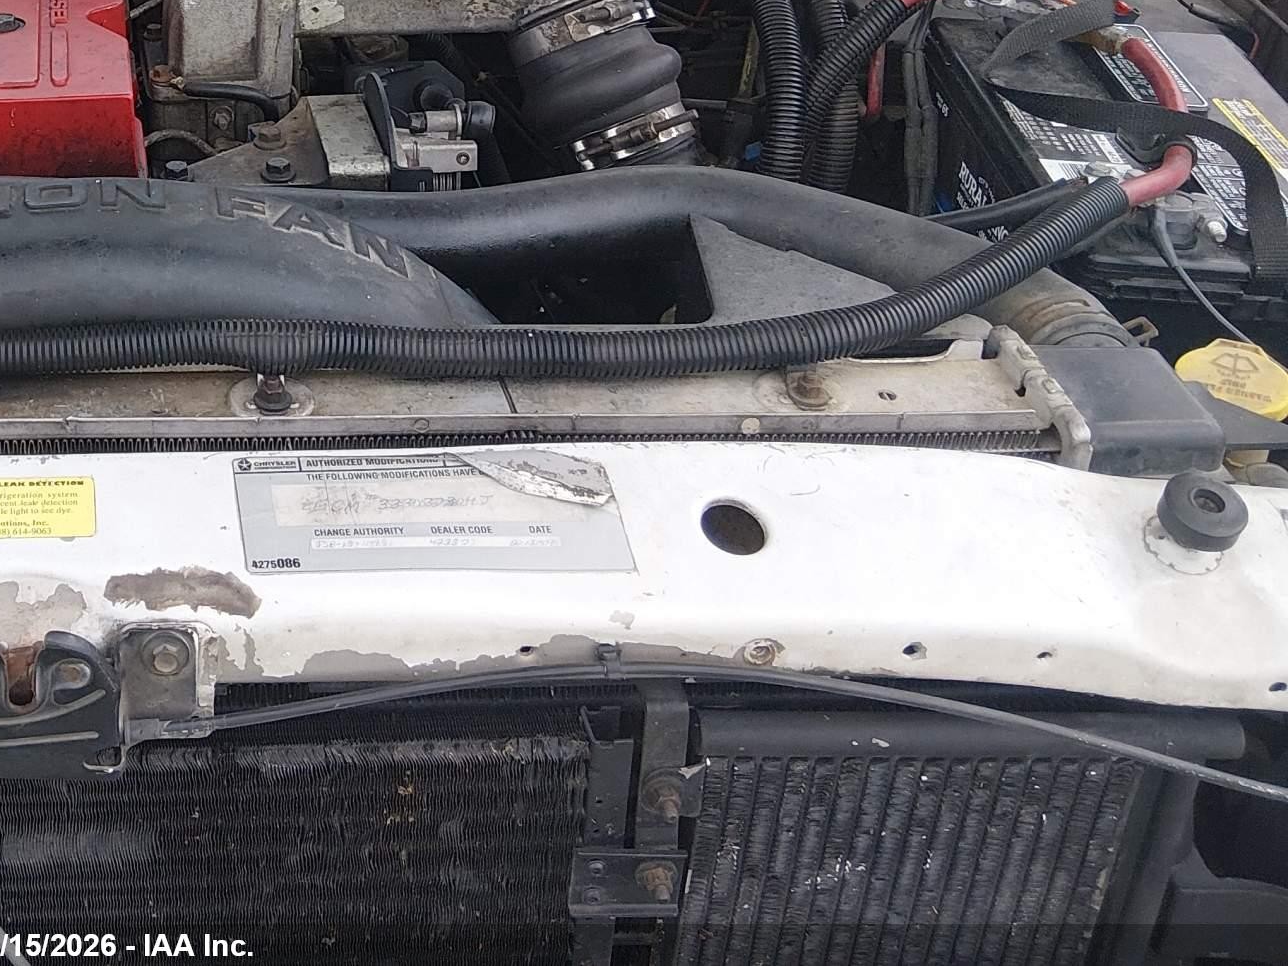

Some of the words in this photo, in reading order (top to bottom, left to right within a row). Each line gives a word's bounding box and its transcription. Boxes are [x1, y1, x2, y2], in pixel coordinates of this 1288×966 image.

[214, 186, 415, 281] FAN
[306, 459, 363, 468] AUTHORIZED
[325, 473, 378, 481] FOLLOWING
[381, 469, 451, 479] MODIFICATIONS
[453, 469, 476, 477] HAVE
[10, 507, 28, 515] light
[12, 527, 52, 535] 614-9063
[314, 529, 351, 537] CHANGE
[353, 527, 404, 536] AUTHORITY
[430, 526, 466, 534] DEALER
[468, 525, 493, 533] CODE
[529, 526, 552, 534] DATE
[251, 558, 301, 569] 4275086
